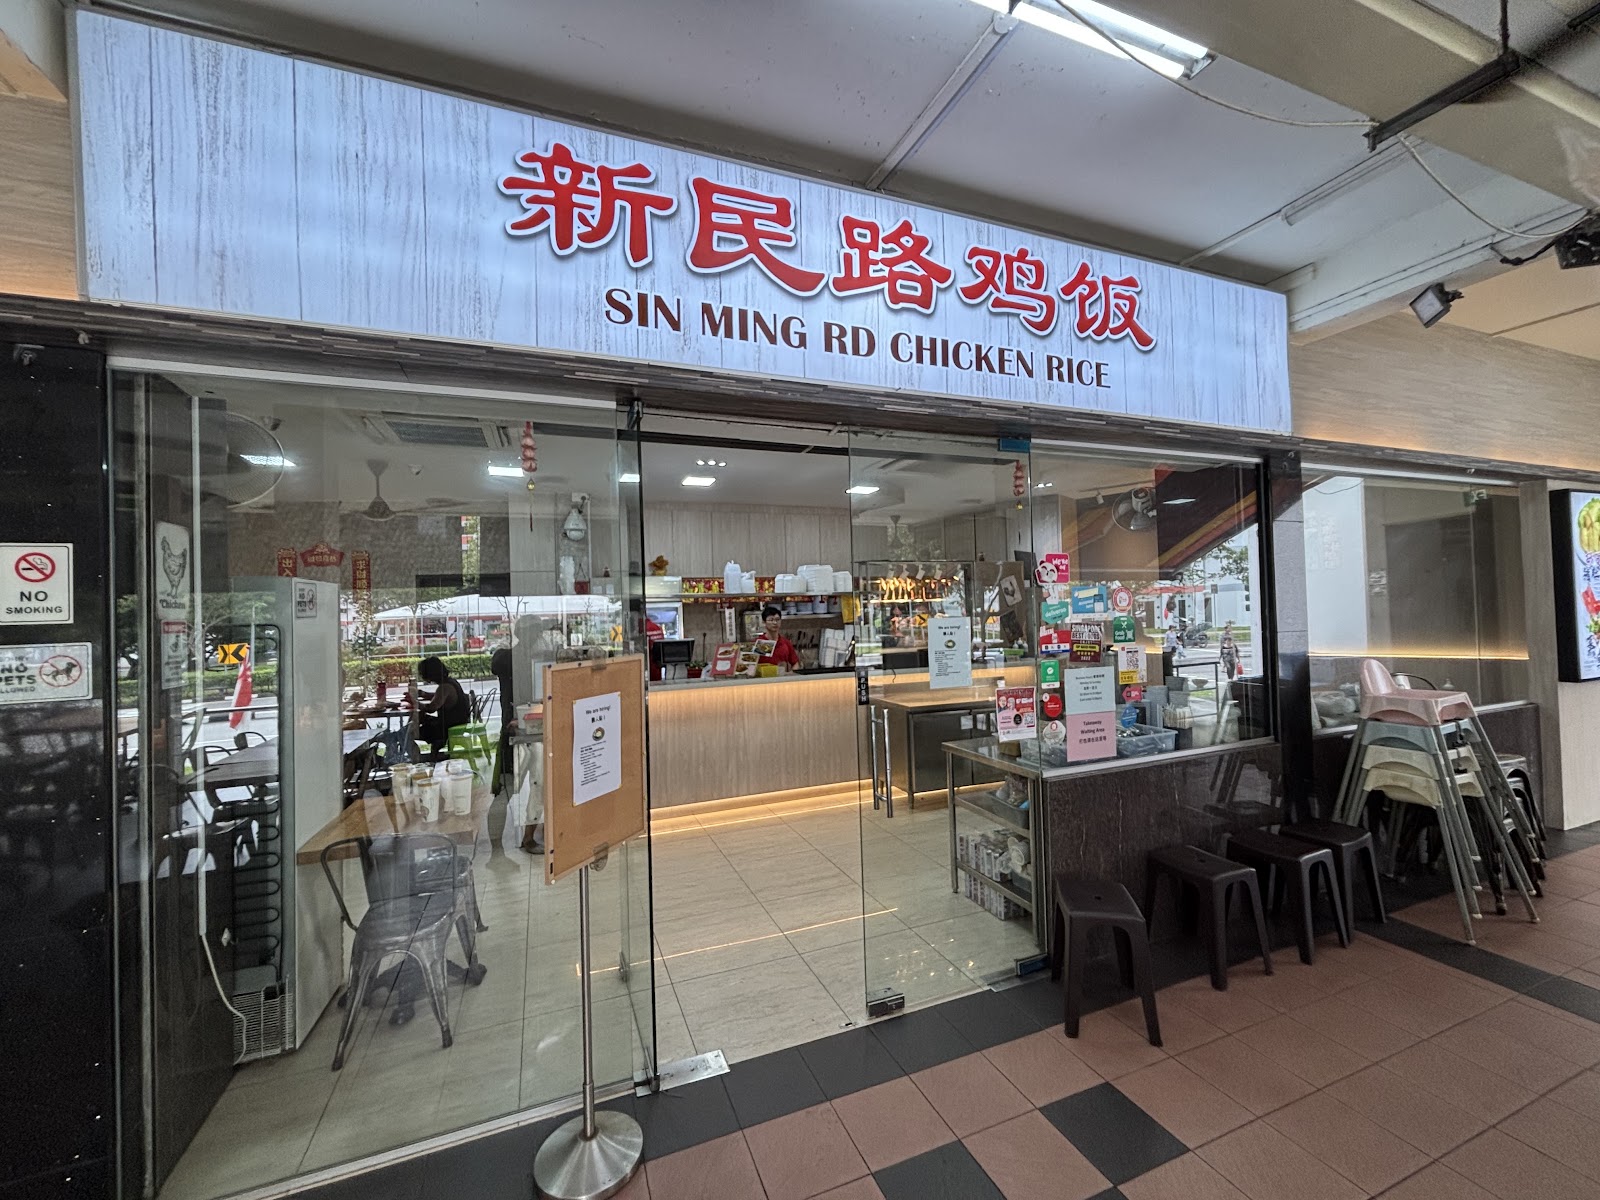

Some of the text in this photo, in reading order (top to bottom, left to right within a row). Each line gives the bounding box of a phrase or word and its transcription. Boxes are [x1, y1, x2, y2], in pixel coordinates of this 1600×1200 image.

[502, 141, 1155, 350] 新民路鸡饭
[604, 288, 1112, 390] SIN MING RD CHICKEN RICE
[19, 590, 49, 602] NO
[159, 598, 186, 609] Chicken
[5, 605, 63, 615] SMOKING
[1045, 607, 1067, 617] deliveroo
[1071, 624, 1101, 633] SINGAPORE
[0, 662, 28, 674] NO
